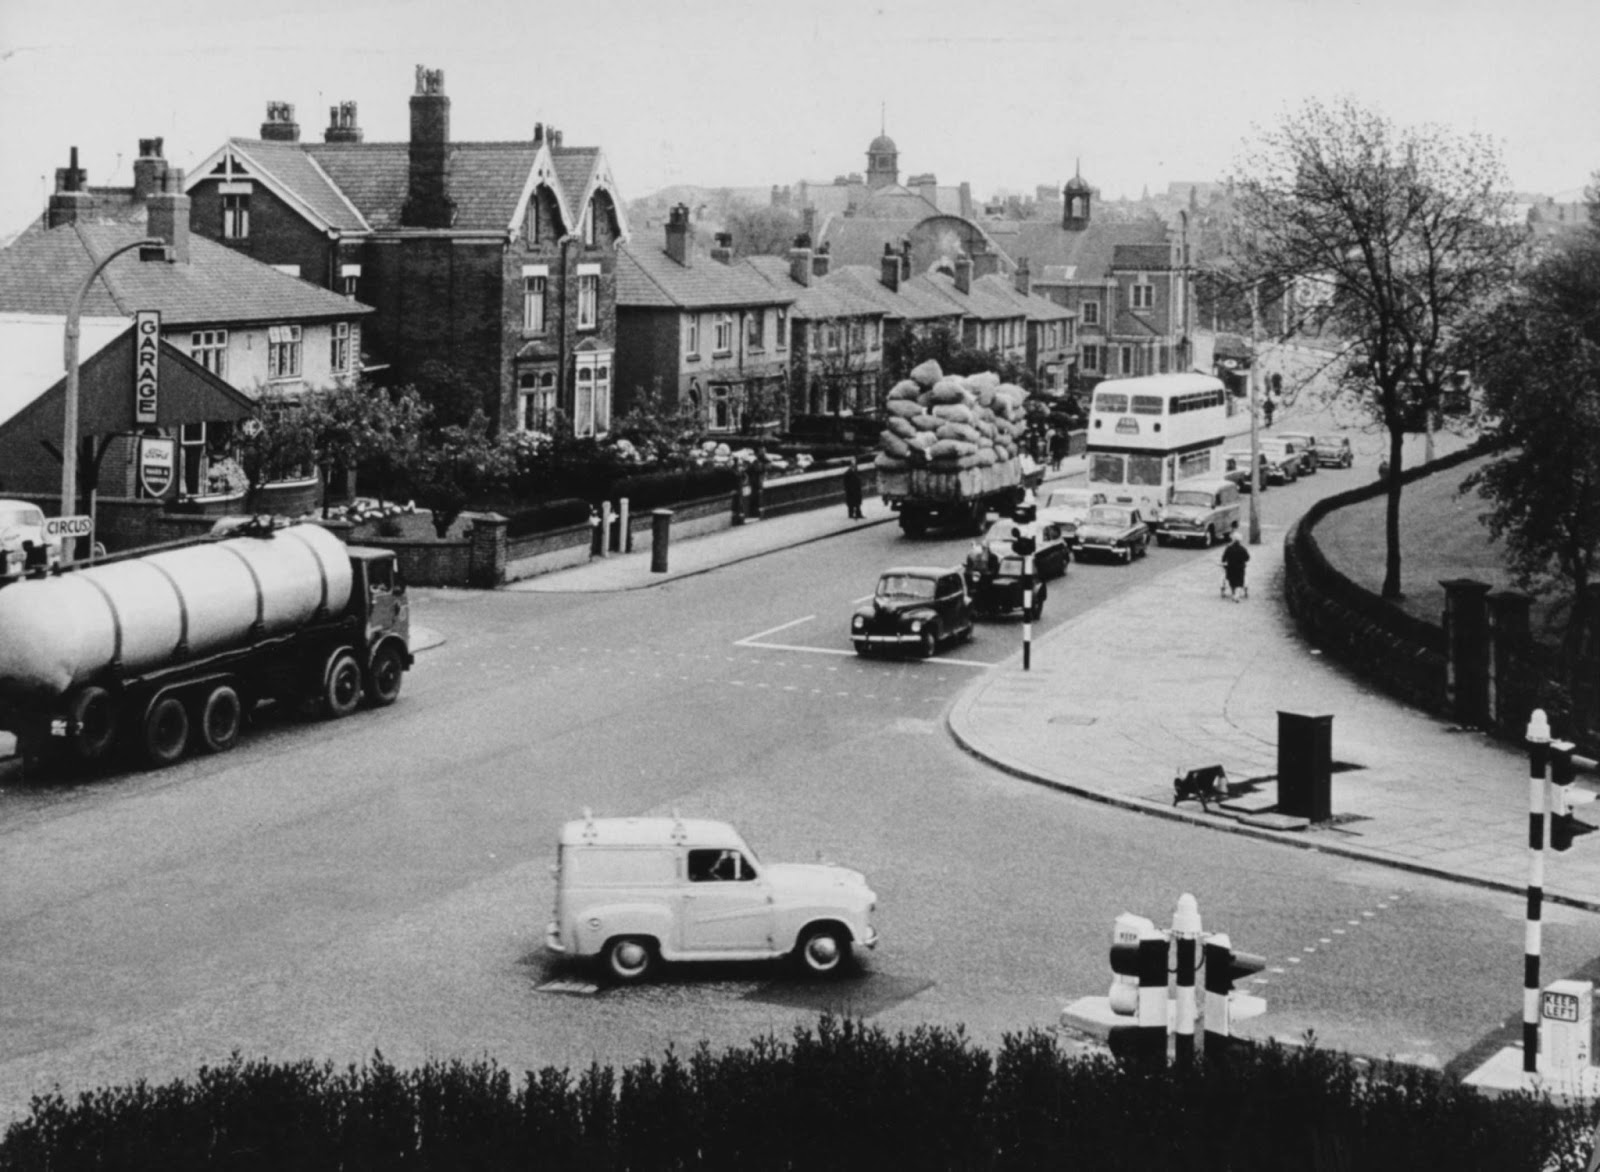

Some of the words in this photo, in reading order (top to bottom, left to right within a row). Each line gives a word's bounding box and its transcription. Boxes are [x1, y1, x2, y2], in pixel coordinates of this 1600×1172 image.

[138, 320, 156, 414] GARAGE
[47, 520, 88, 535] CIRCUS
[1546, 994, 1576, 1006] KEEP
[1546, 1005, 1574, 1017] LEFT
